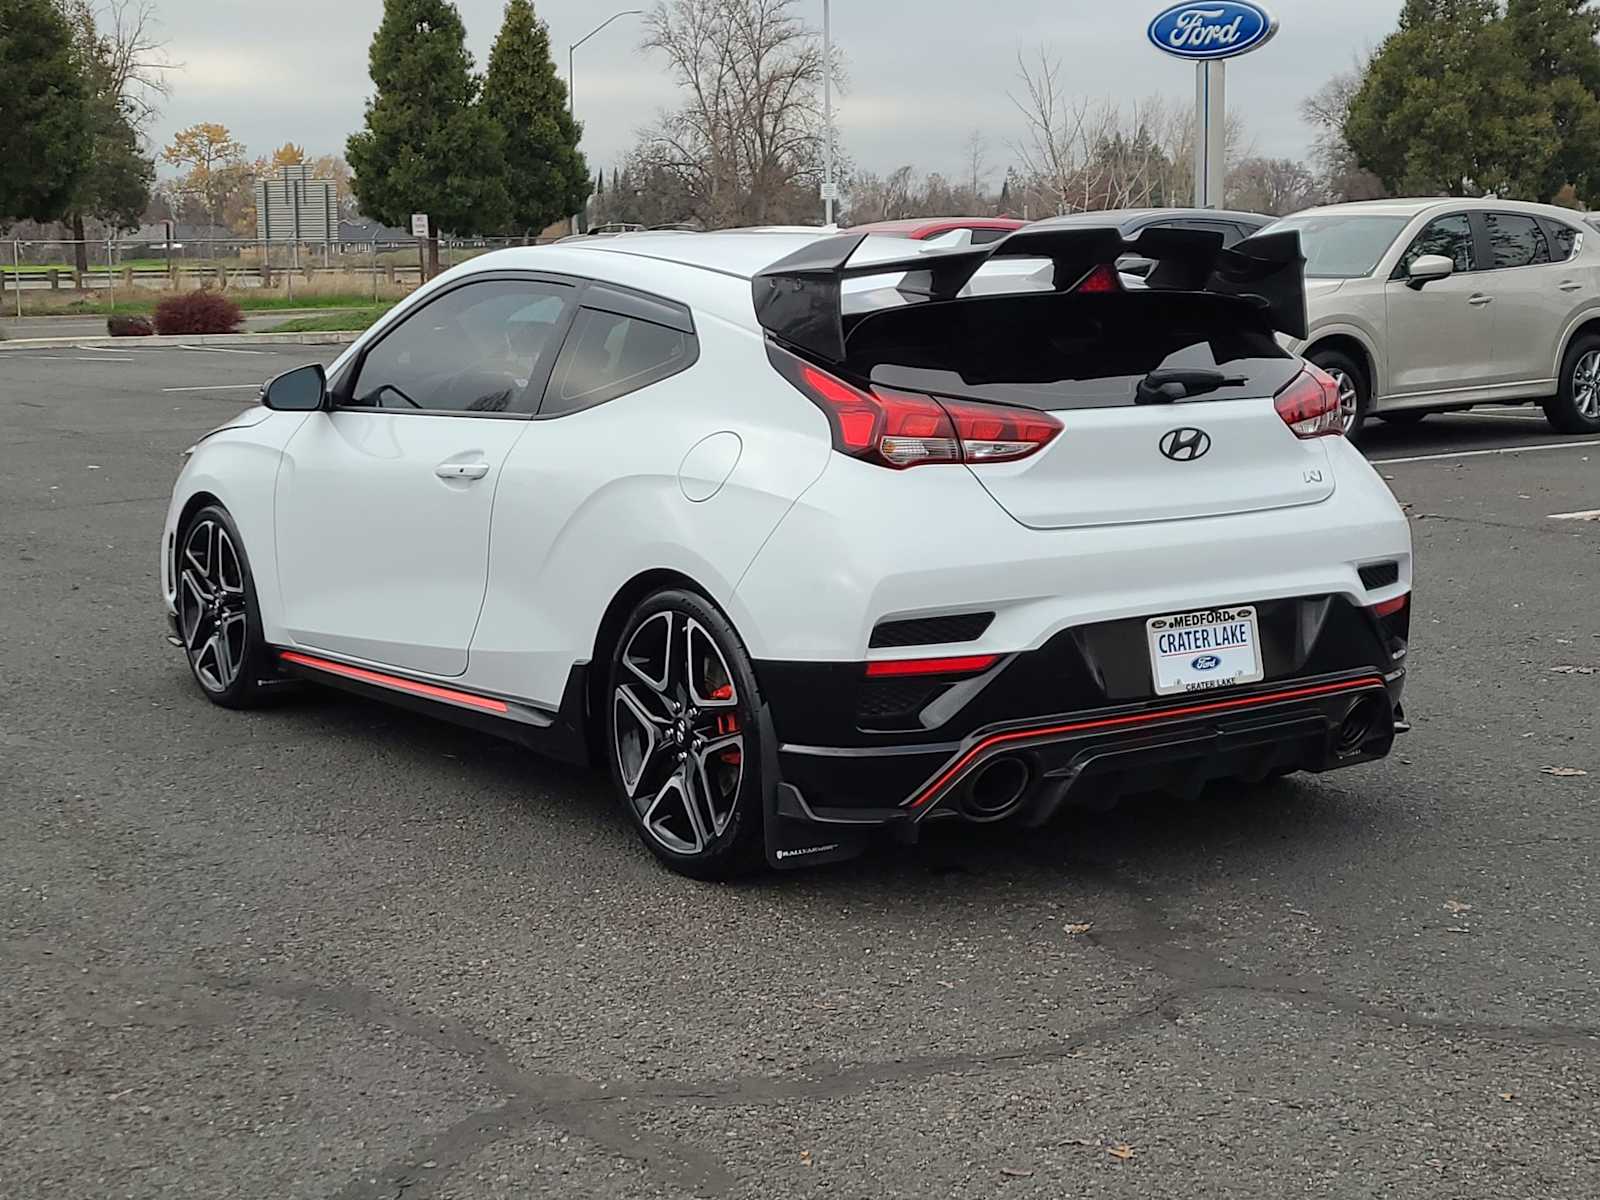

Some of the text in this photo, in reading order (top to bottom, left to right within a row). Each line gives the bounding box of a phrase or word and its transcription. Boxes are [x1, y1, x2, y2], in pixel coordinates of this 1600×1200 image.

[1169, 9, 1243, 46] Ford
[1173, 611, 1231, 628] MEDFORD
[1159, 624, 1247, 654] CRATER LAKE
